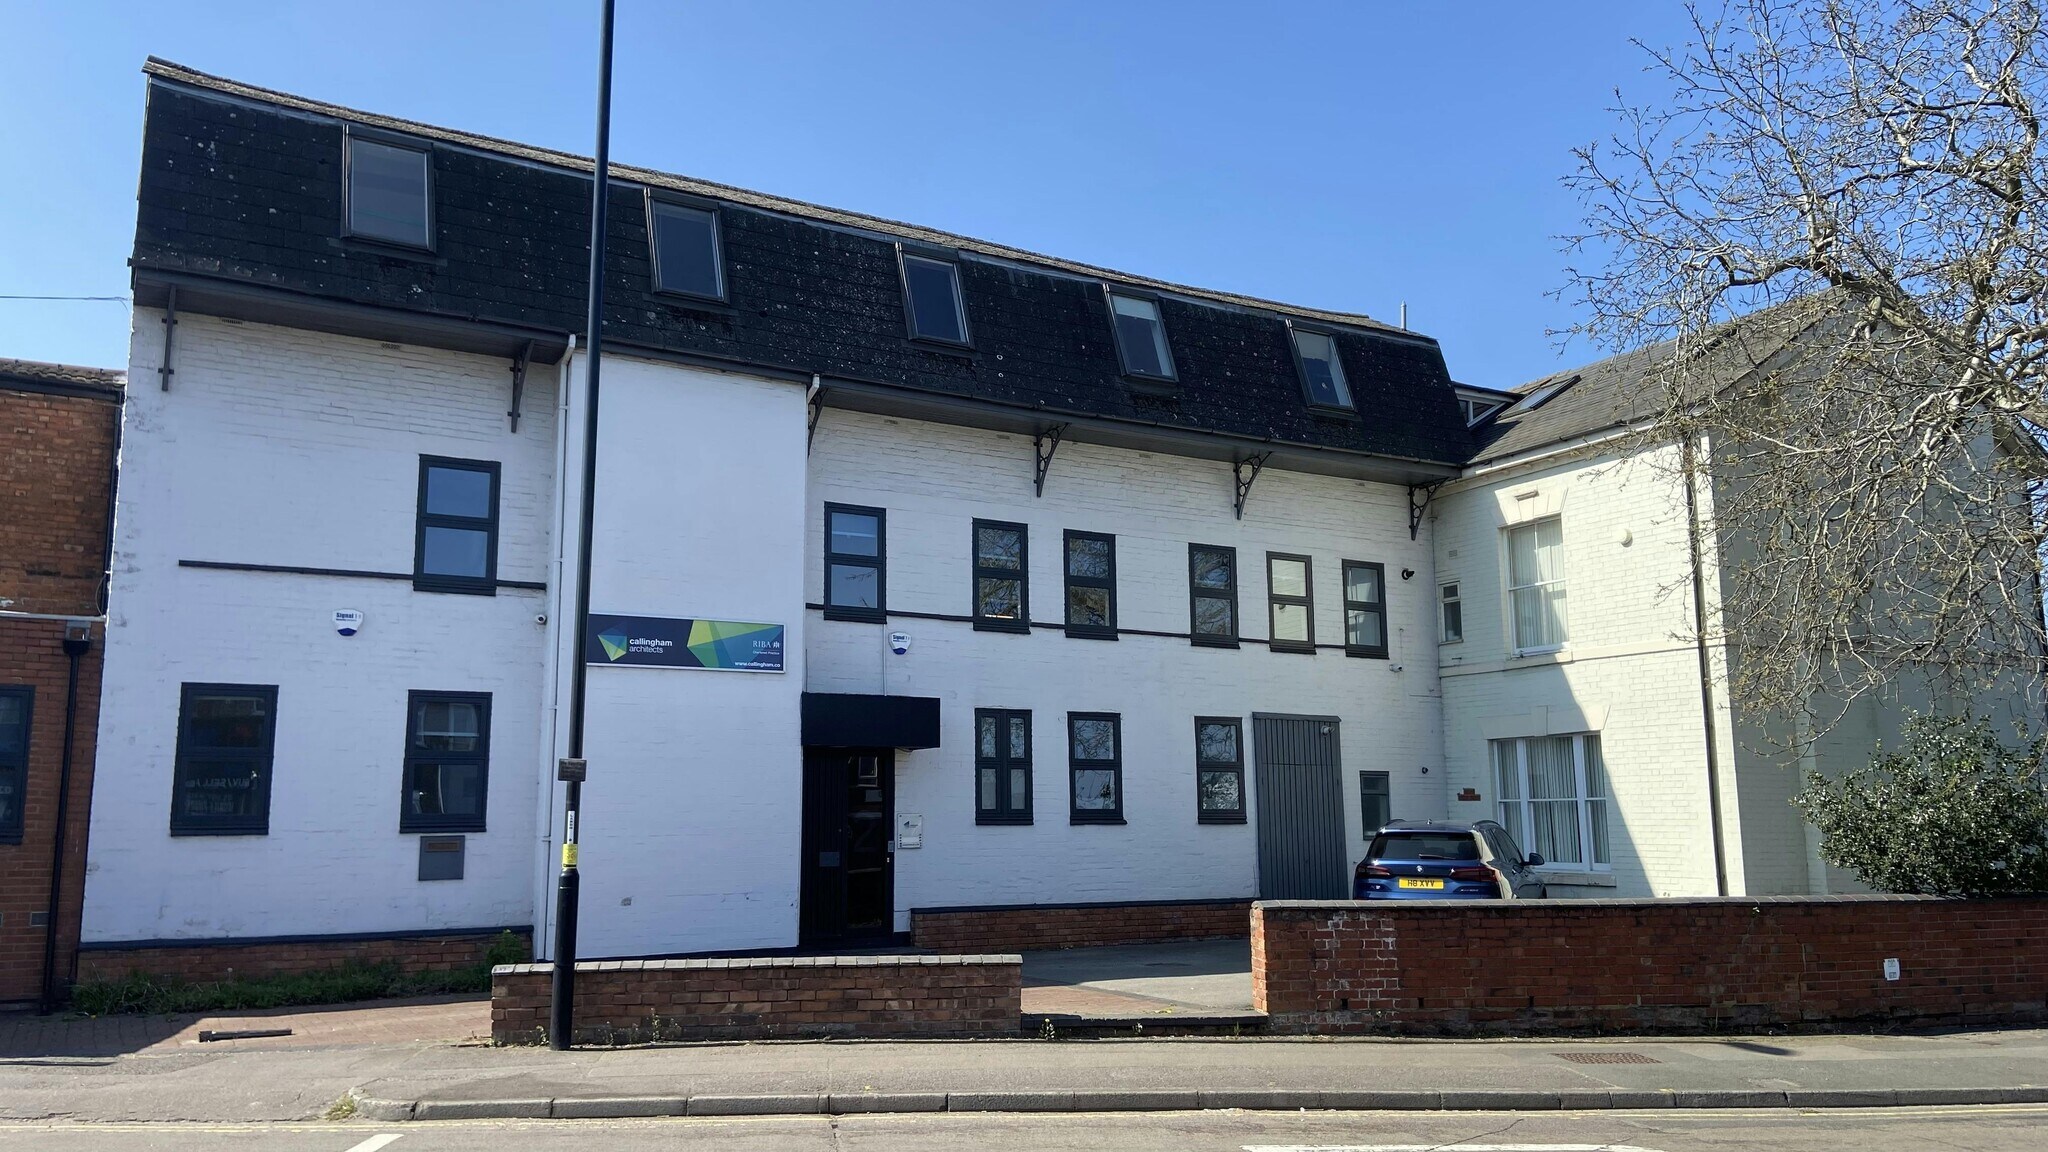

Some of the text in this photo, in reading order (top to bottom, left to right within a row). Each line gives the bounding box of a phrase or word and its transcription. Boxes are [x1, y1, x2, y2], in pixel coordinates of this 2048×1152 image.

[629, 638, 673, 647] callingham
[752, 640, 771, 648] RIBA
[629, 645, 663, 654] architects
